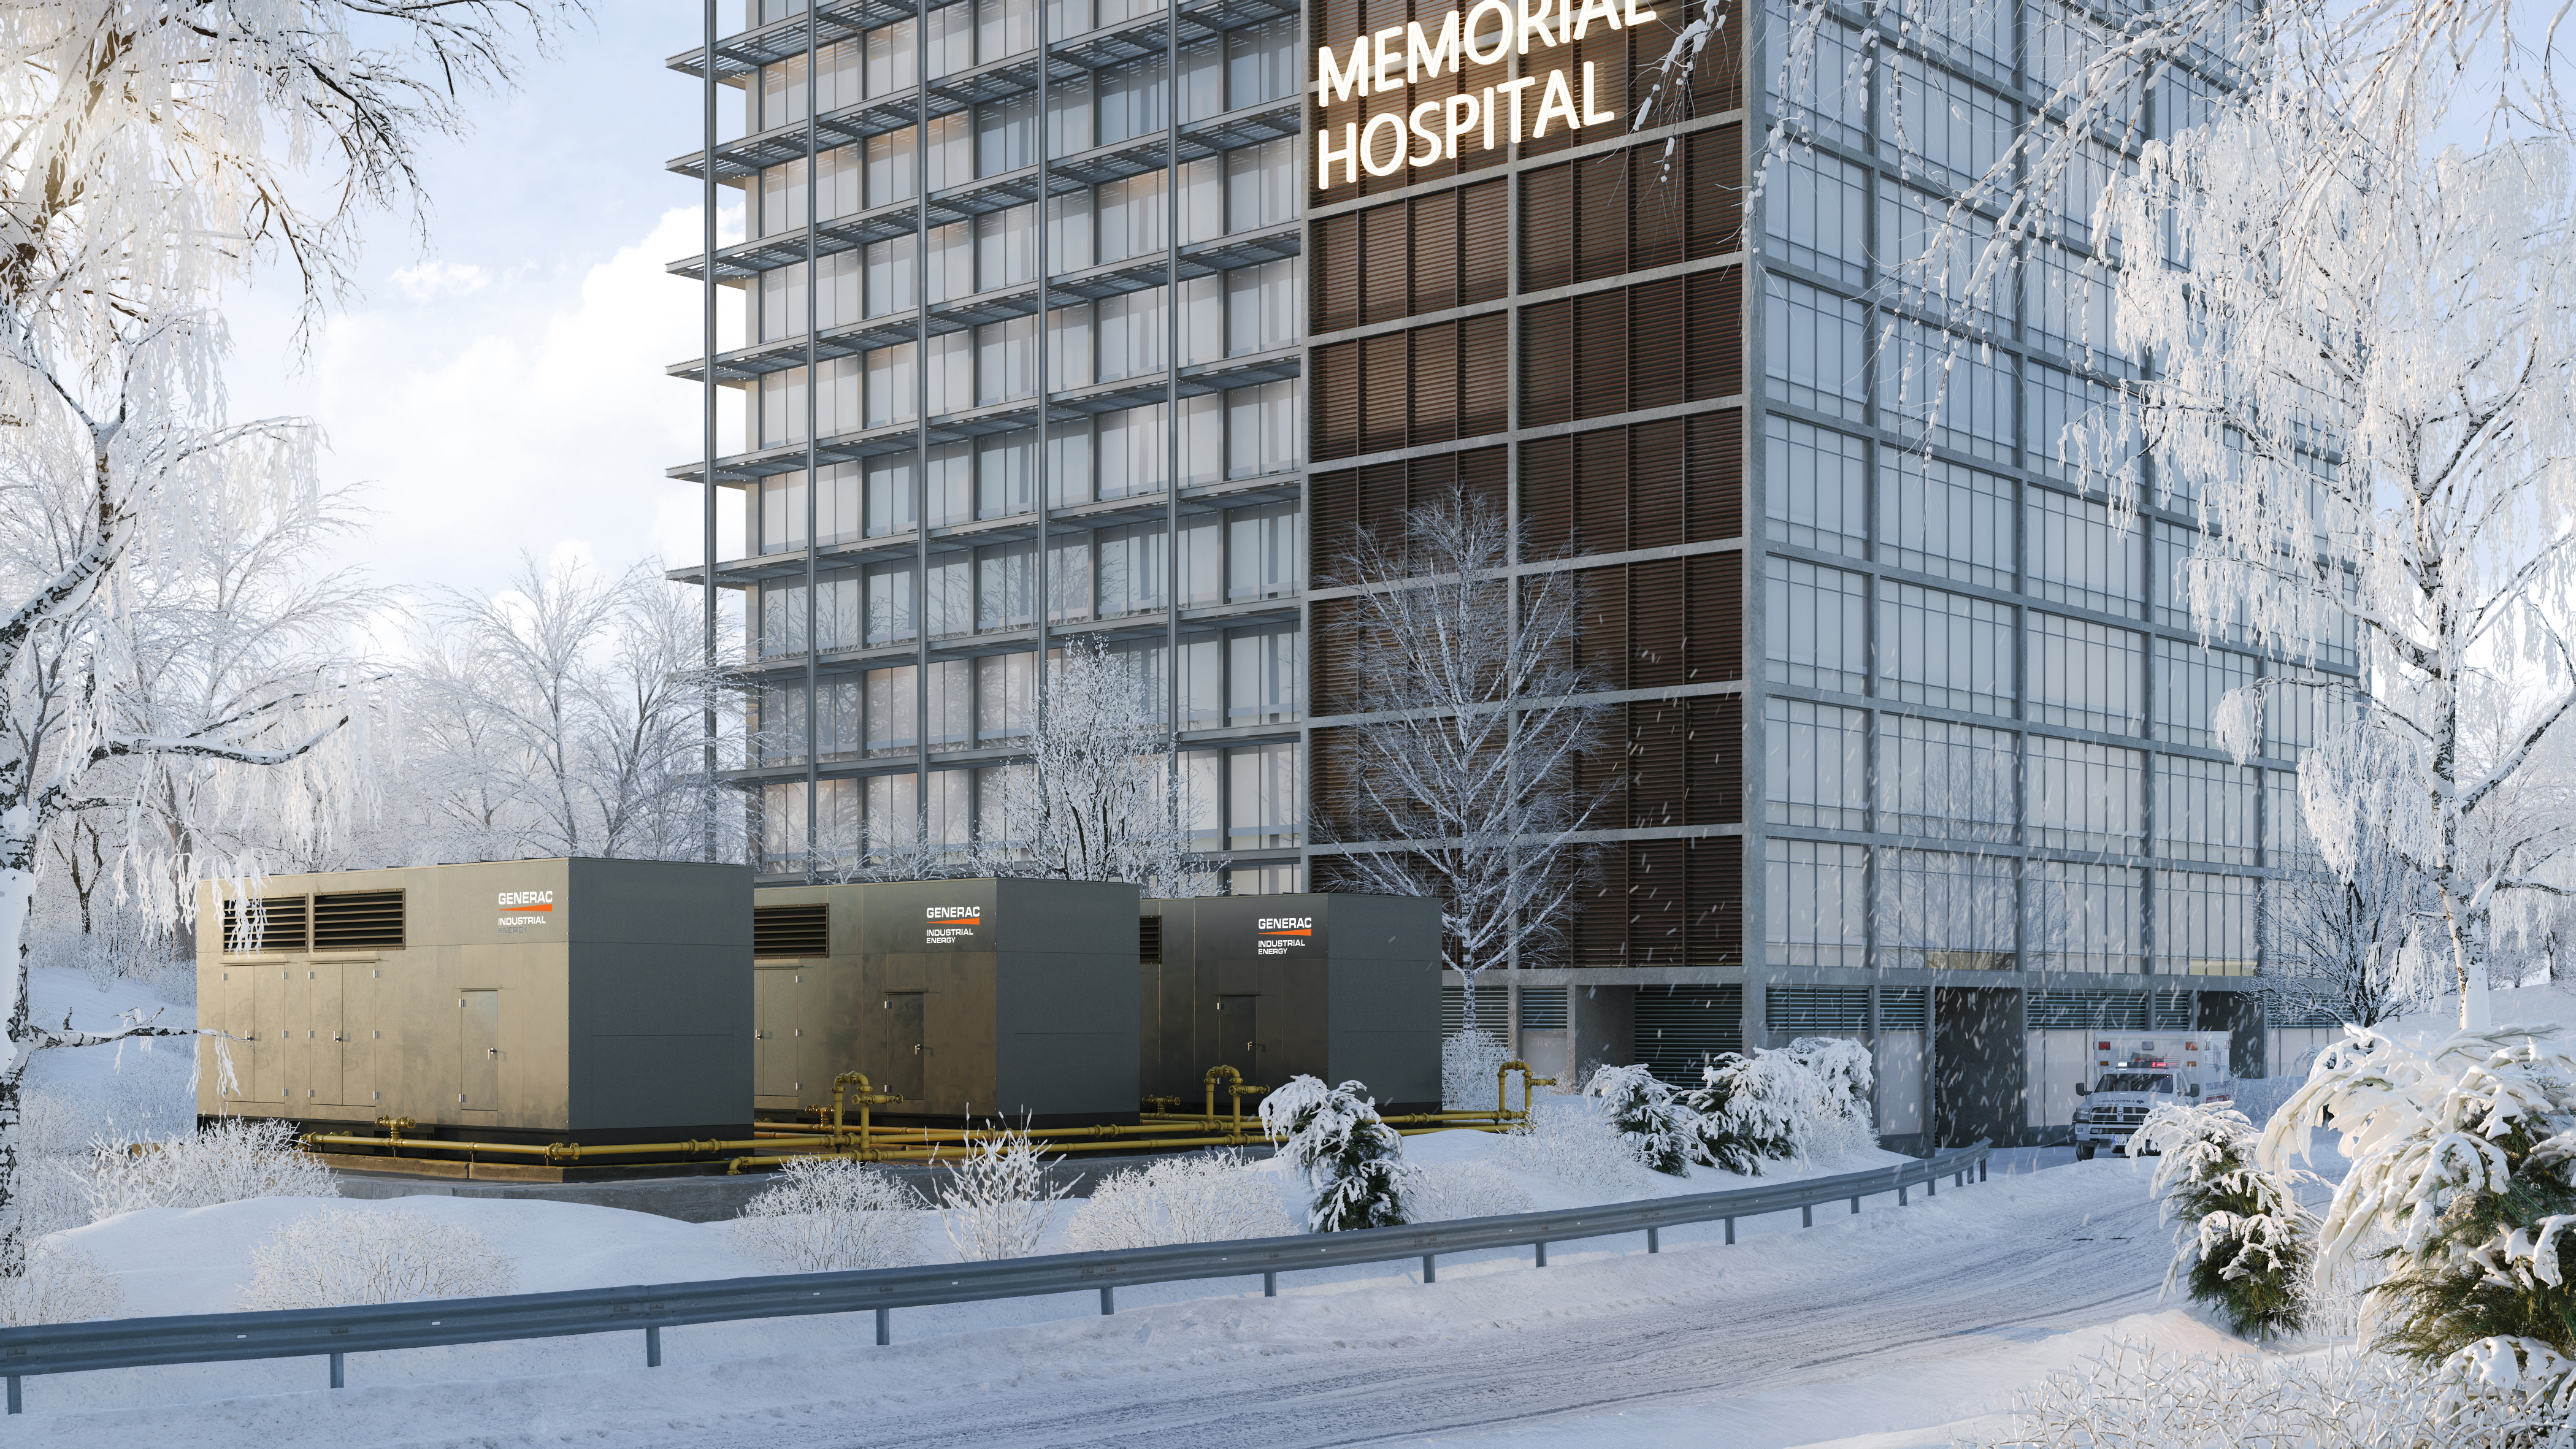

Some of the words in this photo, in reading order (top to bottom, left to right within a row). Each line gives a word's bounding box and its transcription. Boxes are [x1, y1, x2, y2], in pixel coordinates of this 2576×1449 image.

[1318, 61, 1615, 189] HOSPITAL
[498, 890, 553, 905] GENERAC
[926, 906, 980, 919] GENERAC
[498, 916, 546, 926] INDUSTRIAL
[1258, 917, 1312, 930] GENERAC
